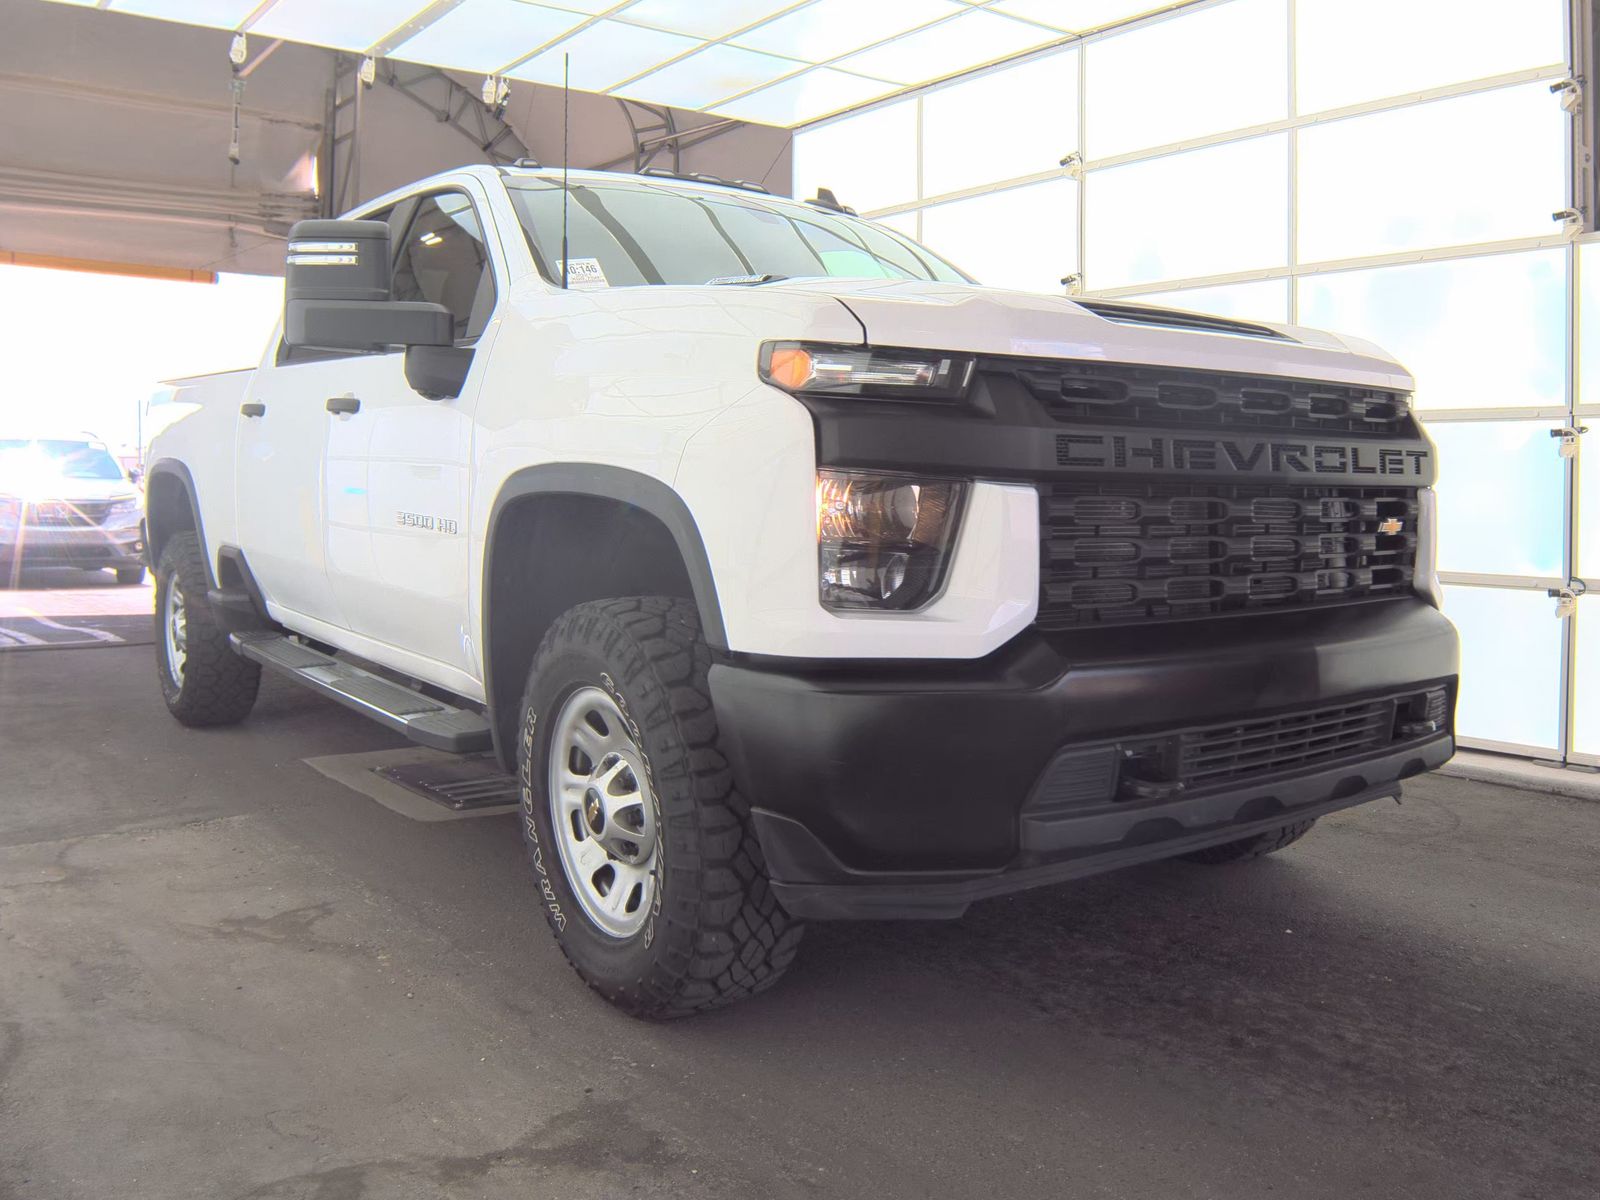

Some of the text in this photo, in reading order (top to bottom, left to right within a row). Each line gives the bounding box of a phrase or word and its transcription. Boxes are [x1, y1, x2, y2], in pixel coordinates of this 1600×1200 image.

[1056, 433, 1428, 475] CHEVROLET
[395, 510, 458, 534] 3500 HD
[520, 705, 567, 932] WRANGLER
